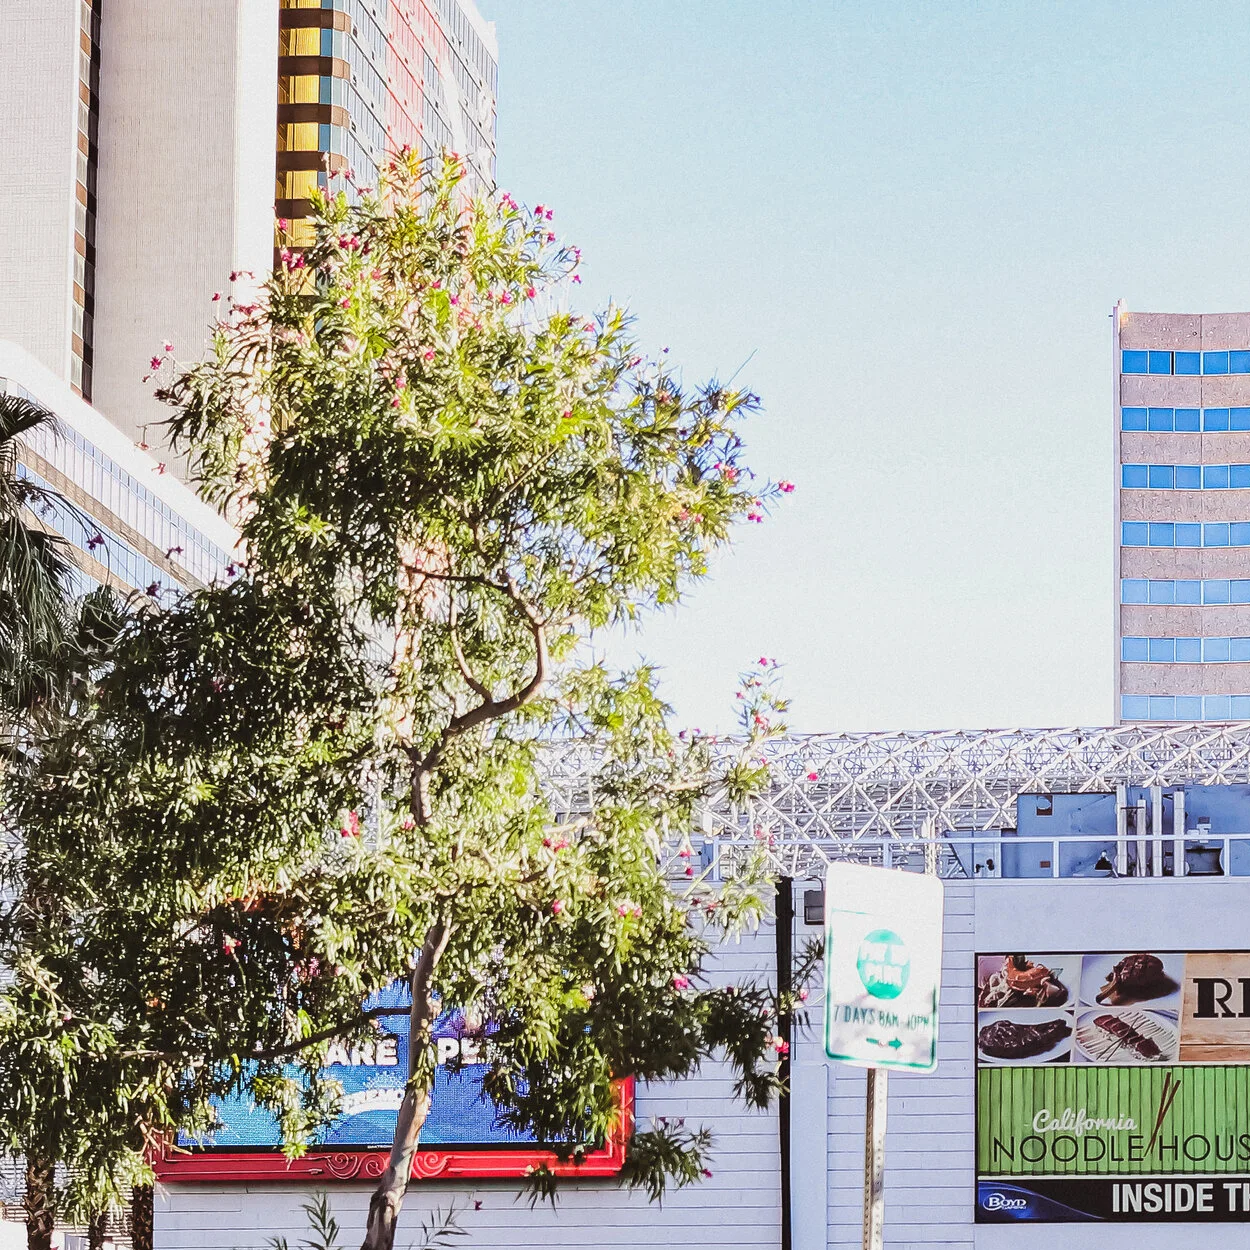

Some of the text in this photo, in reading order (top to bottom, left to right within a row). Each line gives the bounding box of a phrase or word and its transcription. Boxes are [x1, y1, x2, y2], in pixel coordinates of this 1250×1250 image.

[844, 1005, 875, 1025] DAYS
[323, 1036, 399, 1066] ARE
[1033, 1108, 1138, 1136] California
[993, 1135, 1145, 1163] NOODLE
[1112, 1183, 1214, 1213] INSIDE
